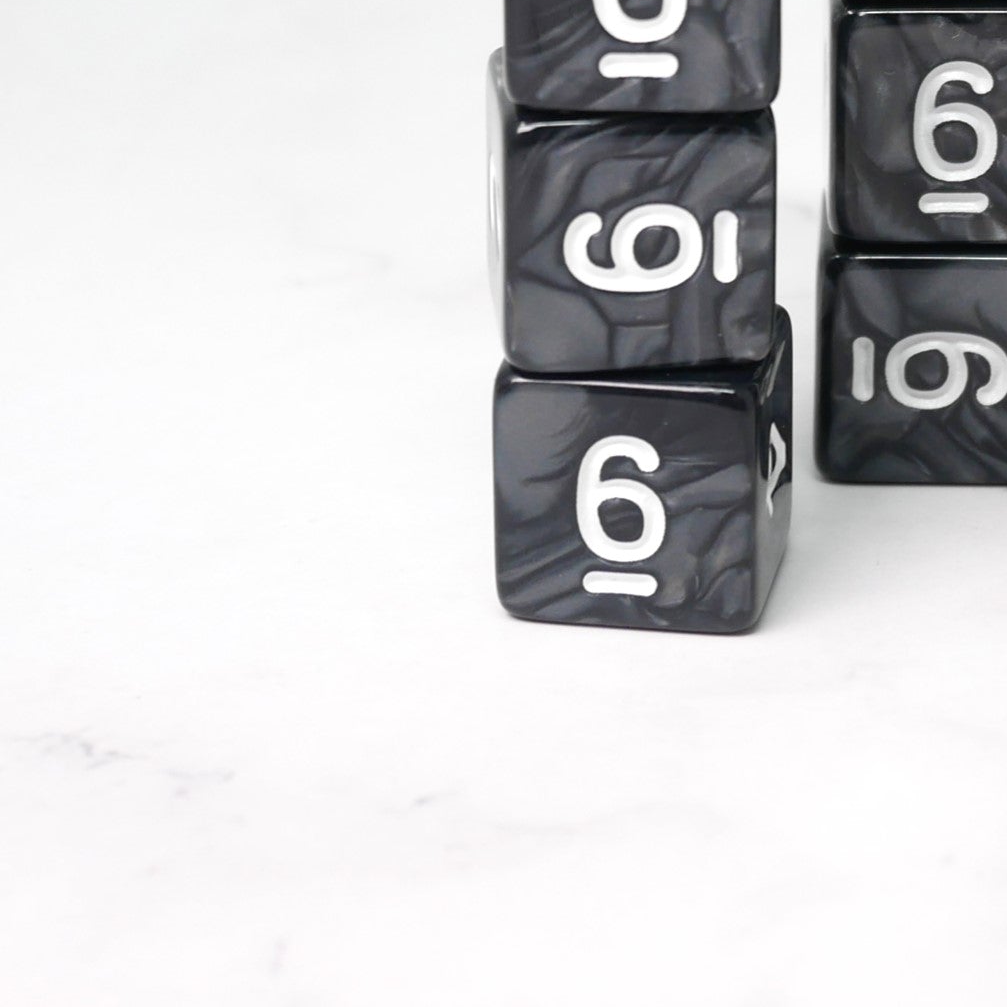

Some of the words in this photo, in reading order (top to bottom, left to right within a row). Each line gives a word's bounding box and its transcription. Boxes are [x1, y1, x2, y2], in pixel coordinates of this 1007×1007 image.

[914, 61, 998, 214] 6
[563, 203, 741, 293] 6
[576, 435, 667, 598] 6
